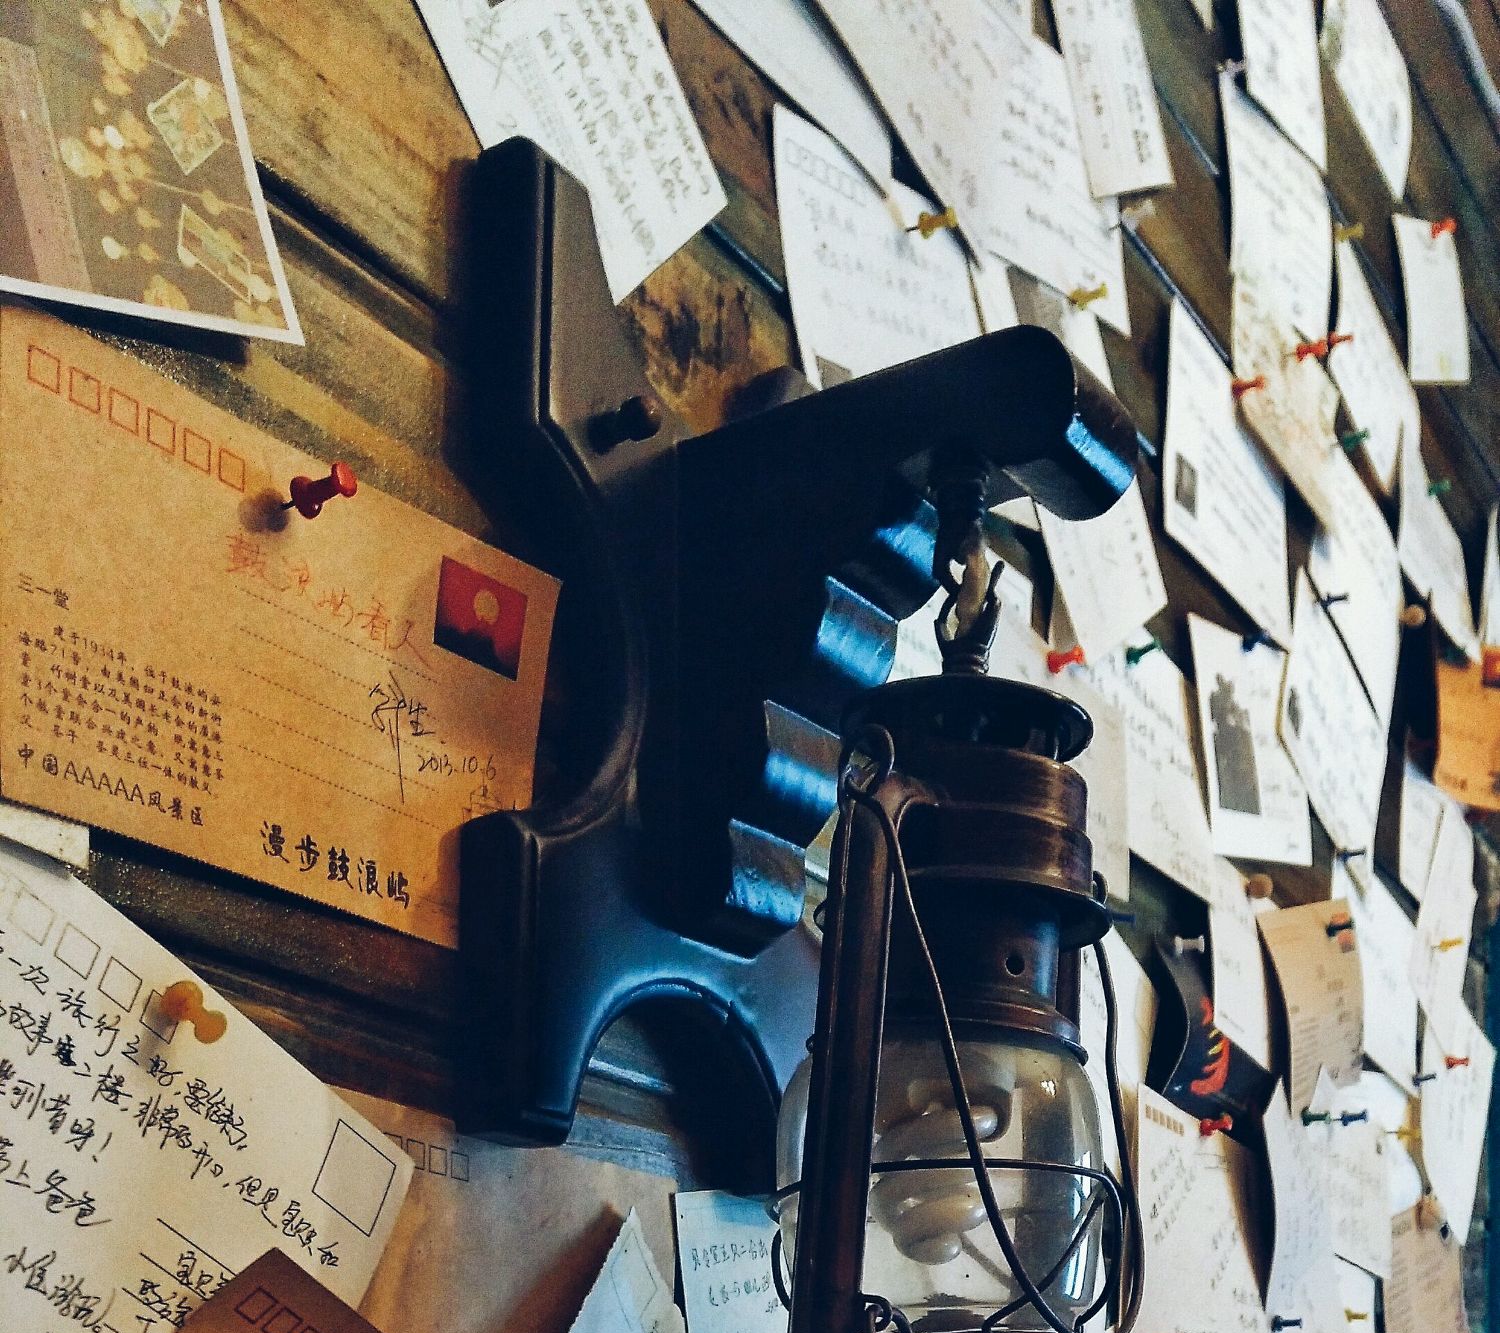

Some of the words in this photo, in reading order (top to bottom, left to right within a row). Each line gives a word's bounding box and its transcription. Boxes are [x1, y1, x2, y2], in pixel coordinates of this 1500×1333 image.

[17, 573, 70, 612] 三一堂
[18, 743, 204, 826] 中国AAAAA风景区
[260, 820, 410, 910] 漫步鼓浪屿
